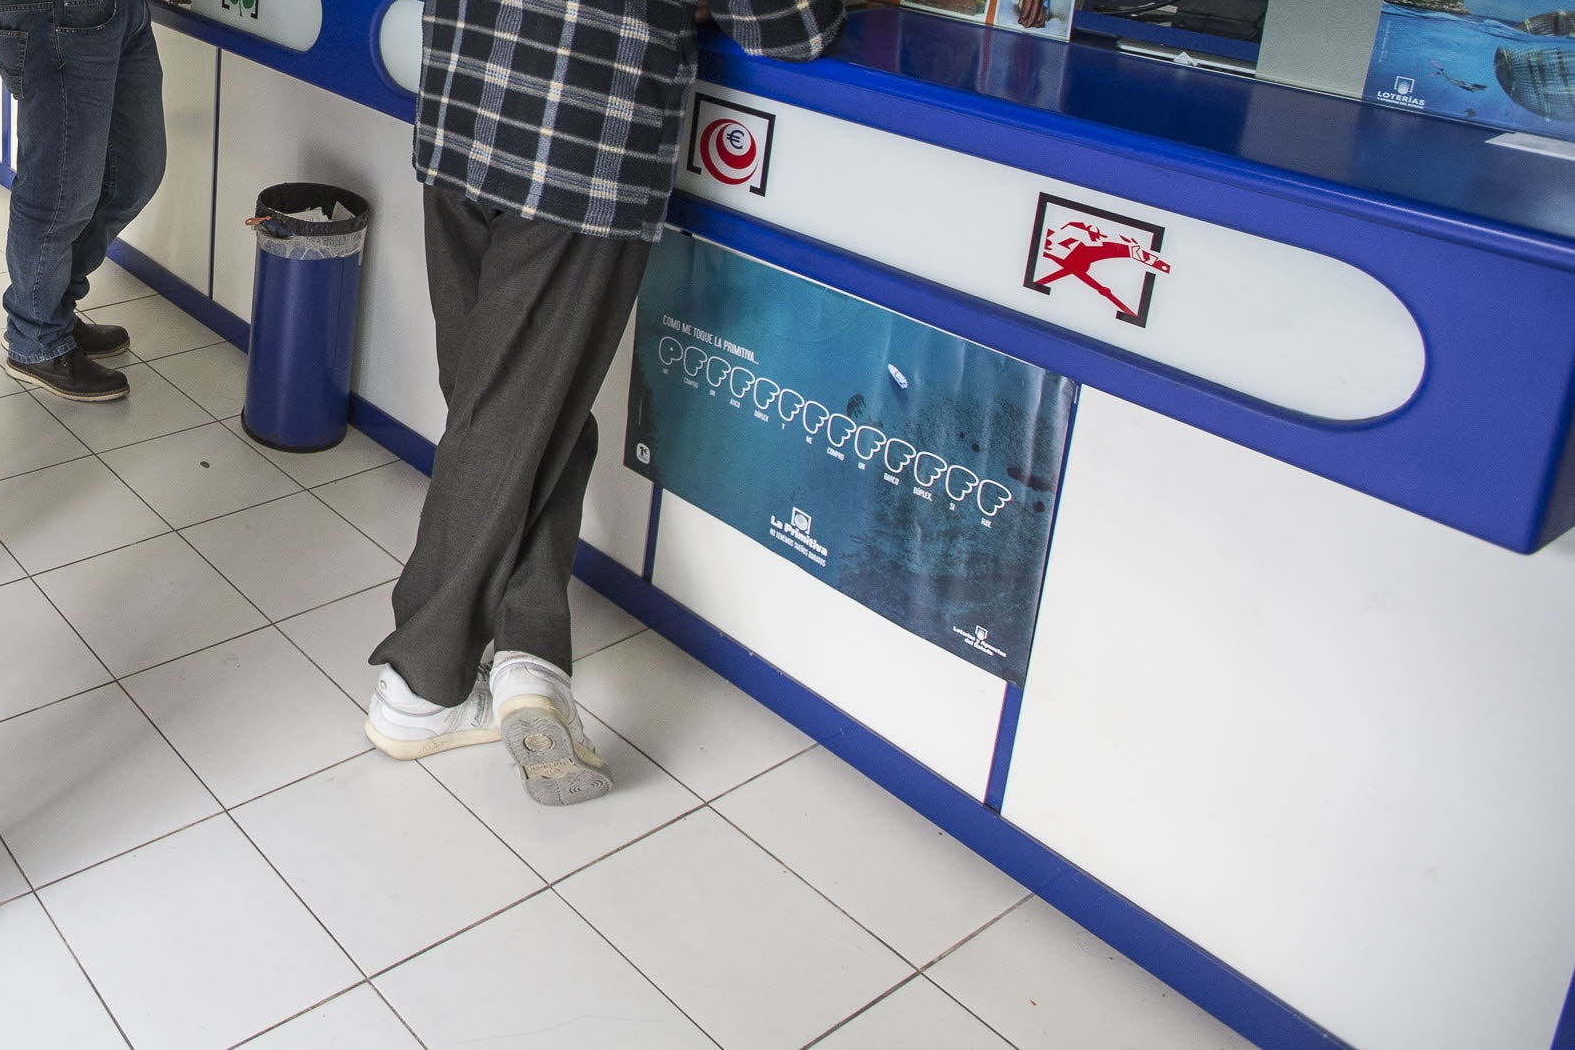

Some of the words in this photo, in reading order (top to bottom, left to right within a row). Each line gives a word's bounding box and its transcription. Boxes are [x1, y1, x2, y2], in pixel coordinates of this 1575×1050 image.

[1377, 91, 1425, 106] LOTERÍAS
[663, 315, 681, 331] COMO
[682, 323, 692, 336] ME
[693, 327, 713, 345] TOQUE
[714, 336, 722, 349] LA
[826, 446, 845, 461] COMPRO
[858, 461, 865, 470] UN
[883, 472, 900, 486] BARCO
[949, 502, 956, 511] SI
[771, 515, 783, 529] La
[784, 523, 828, 557] Primitiva
